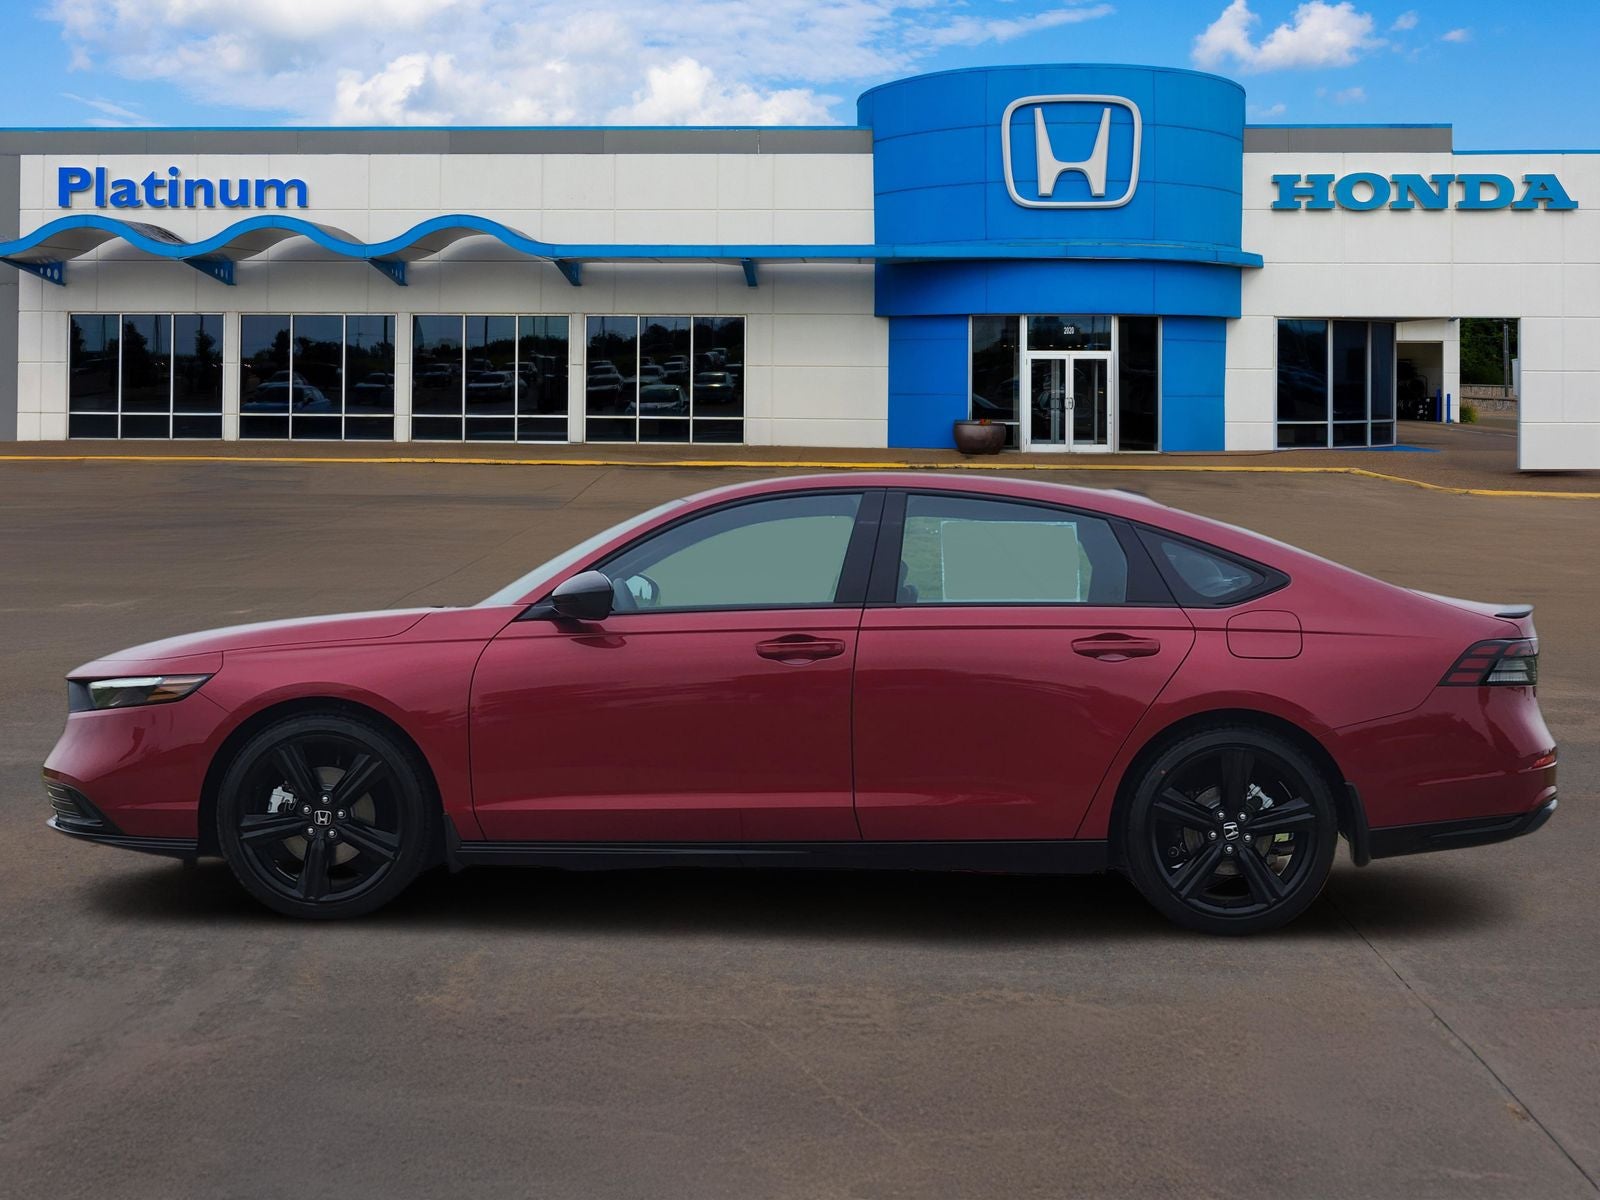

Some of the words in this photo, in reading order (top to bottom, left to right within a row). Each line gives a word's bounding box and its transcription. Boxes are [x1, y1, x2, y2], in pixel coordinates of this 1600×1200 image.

[1034, 107, 1111, 196] H
[58, 166, 308, 208] Platinum
[1271, 172, 1579, 210] HONDA
